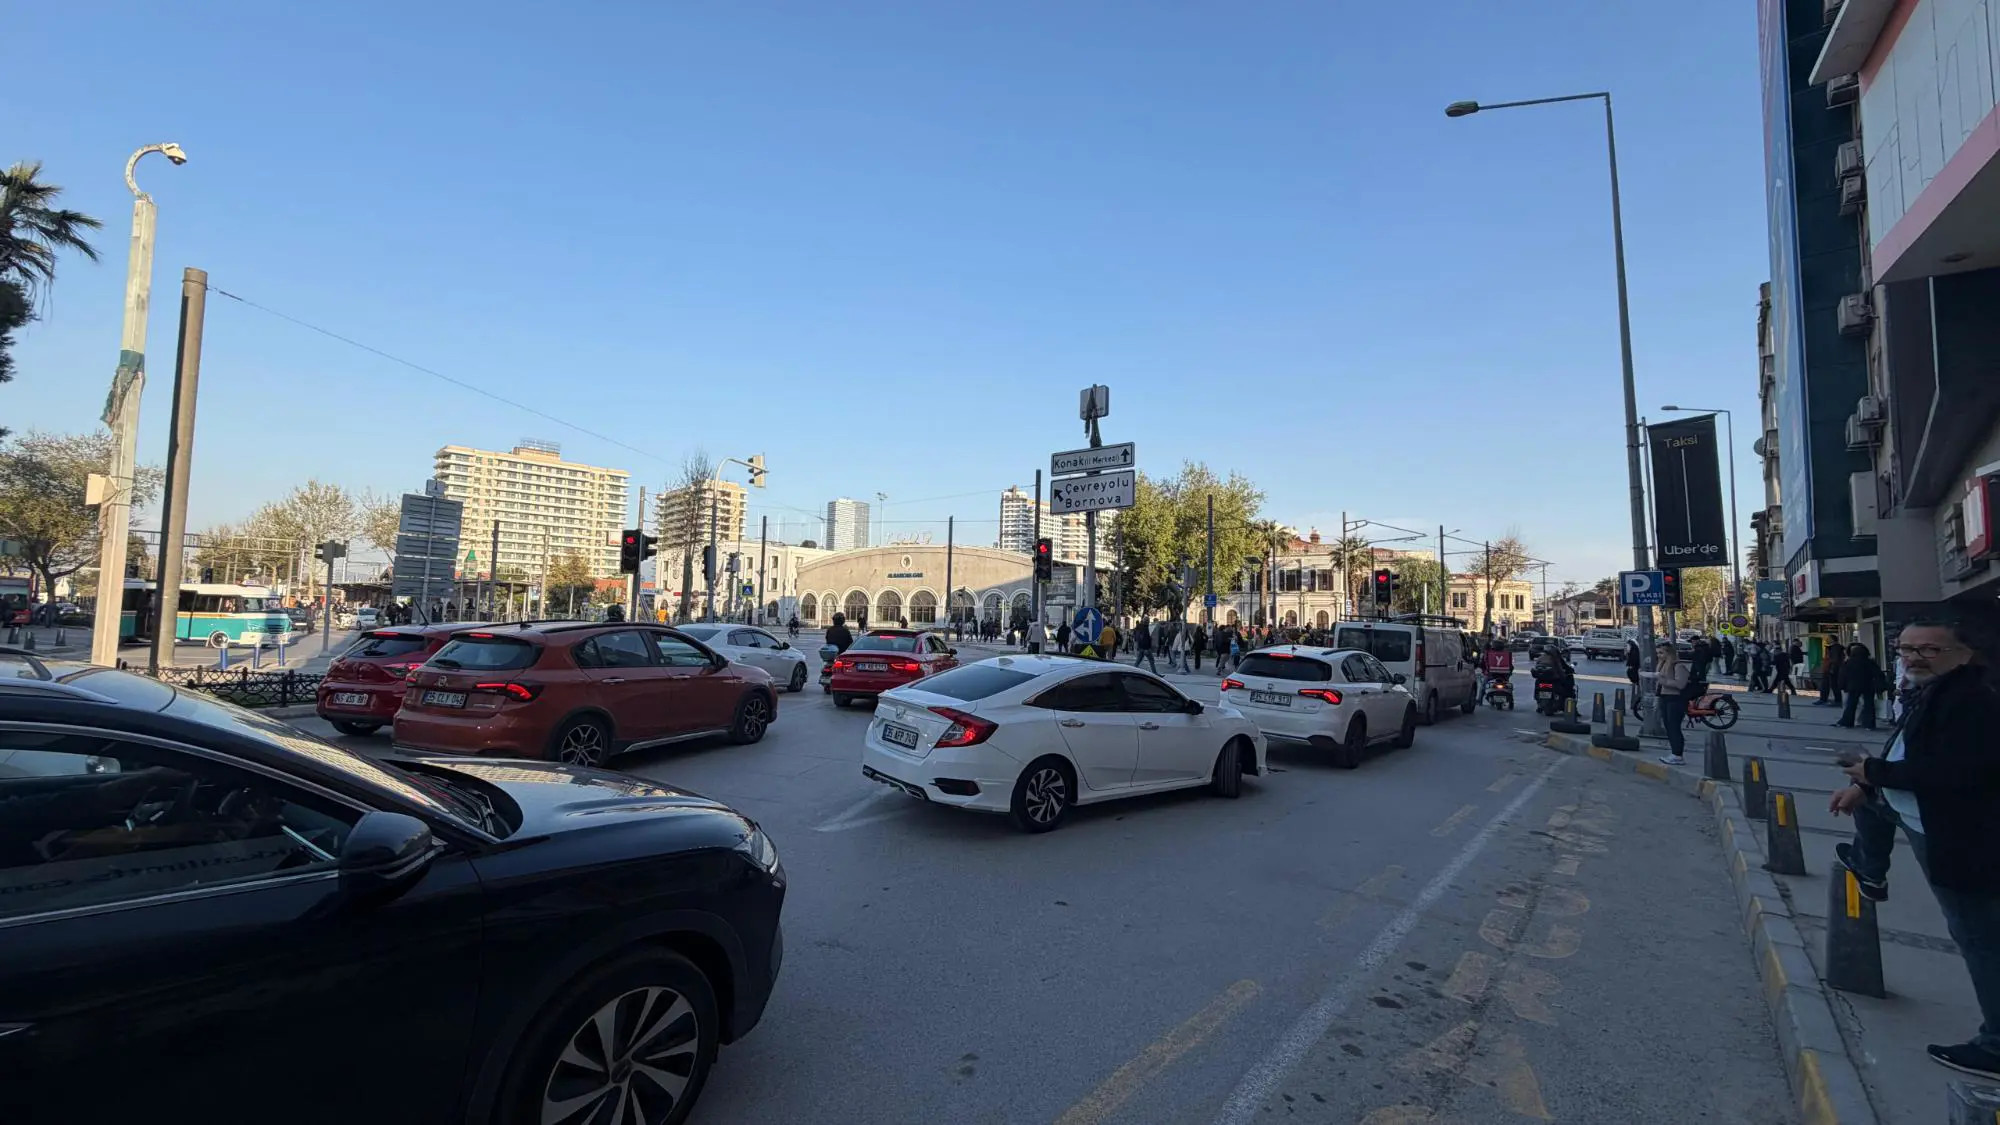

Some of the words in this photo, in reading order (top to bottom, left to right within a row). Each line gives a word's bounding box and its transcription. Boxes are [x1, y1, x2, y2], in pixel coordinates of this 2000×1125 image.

[1664, 435, 1698, 448] Taksi
[1054, 455, 1084, 469] Konak
[1065, 477, 1129, 495] Çevreyolu
[1065, 495, 1121, 508] Bornova
[1664, 543, 1719, 555] Uber'de
[1625, 573, 1651, 603] P
